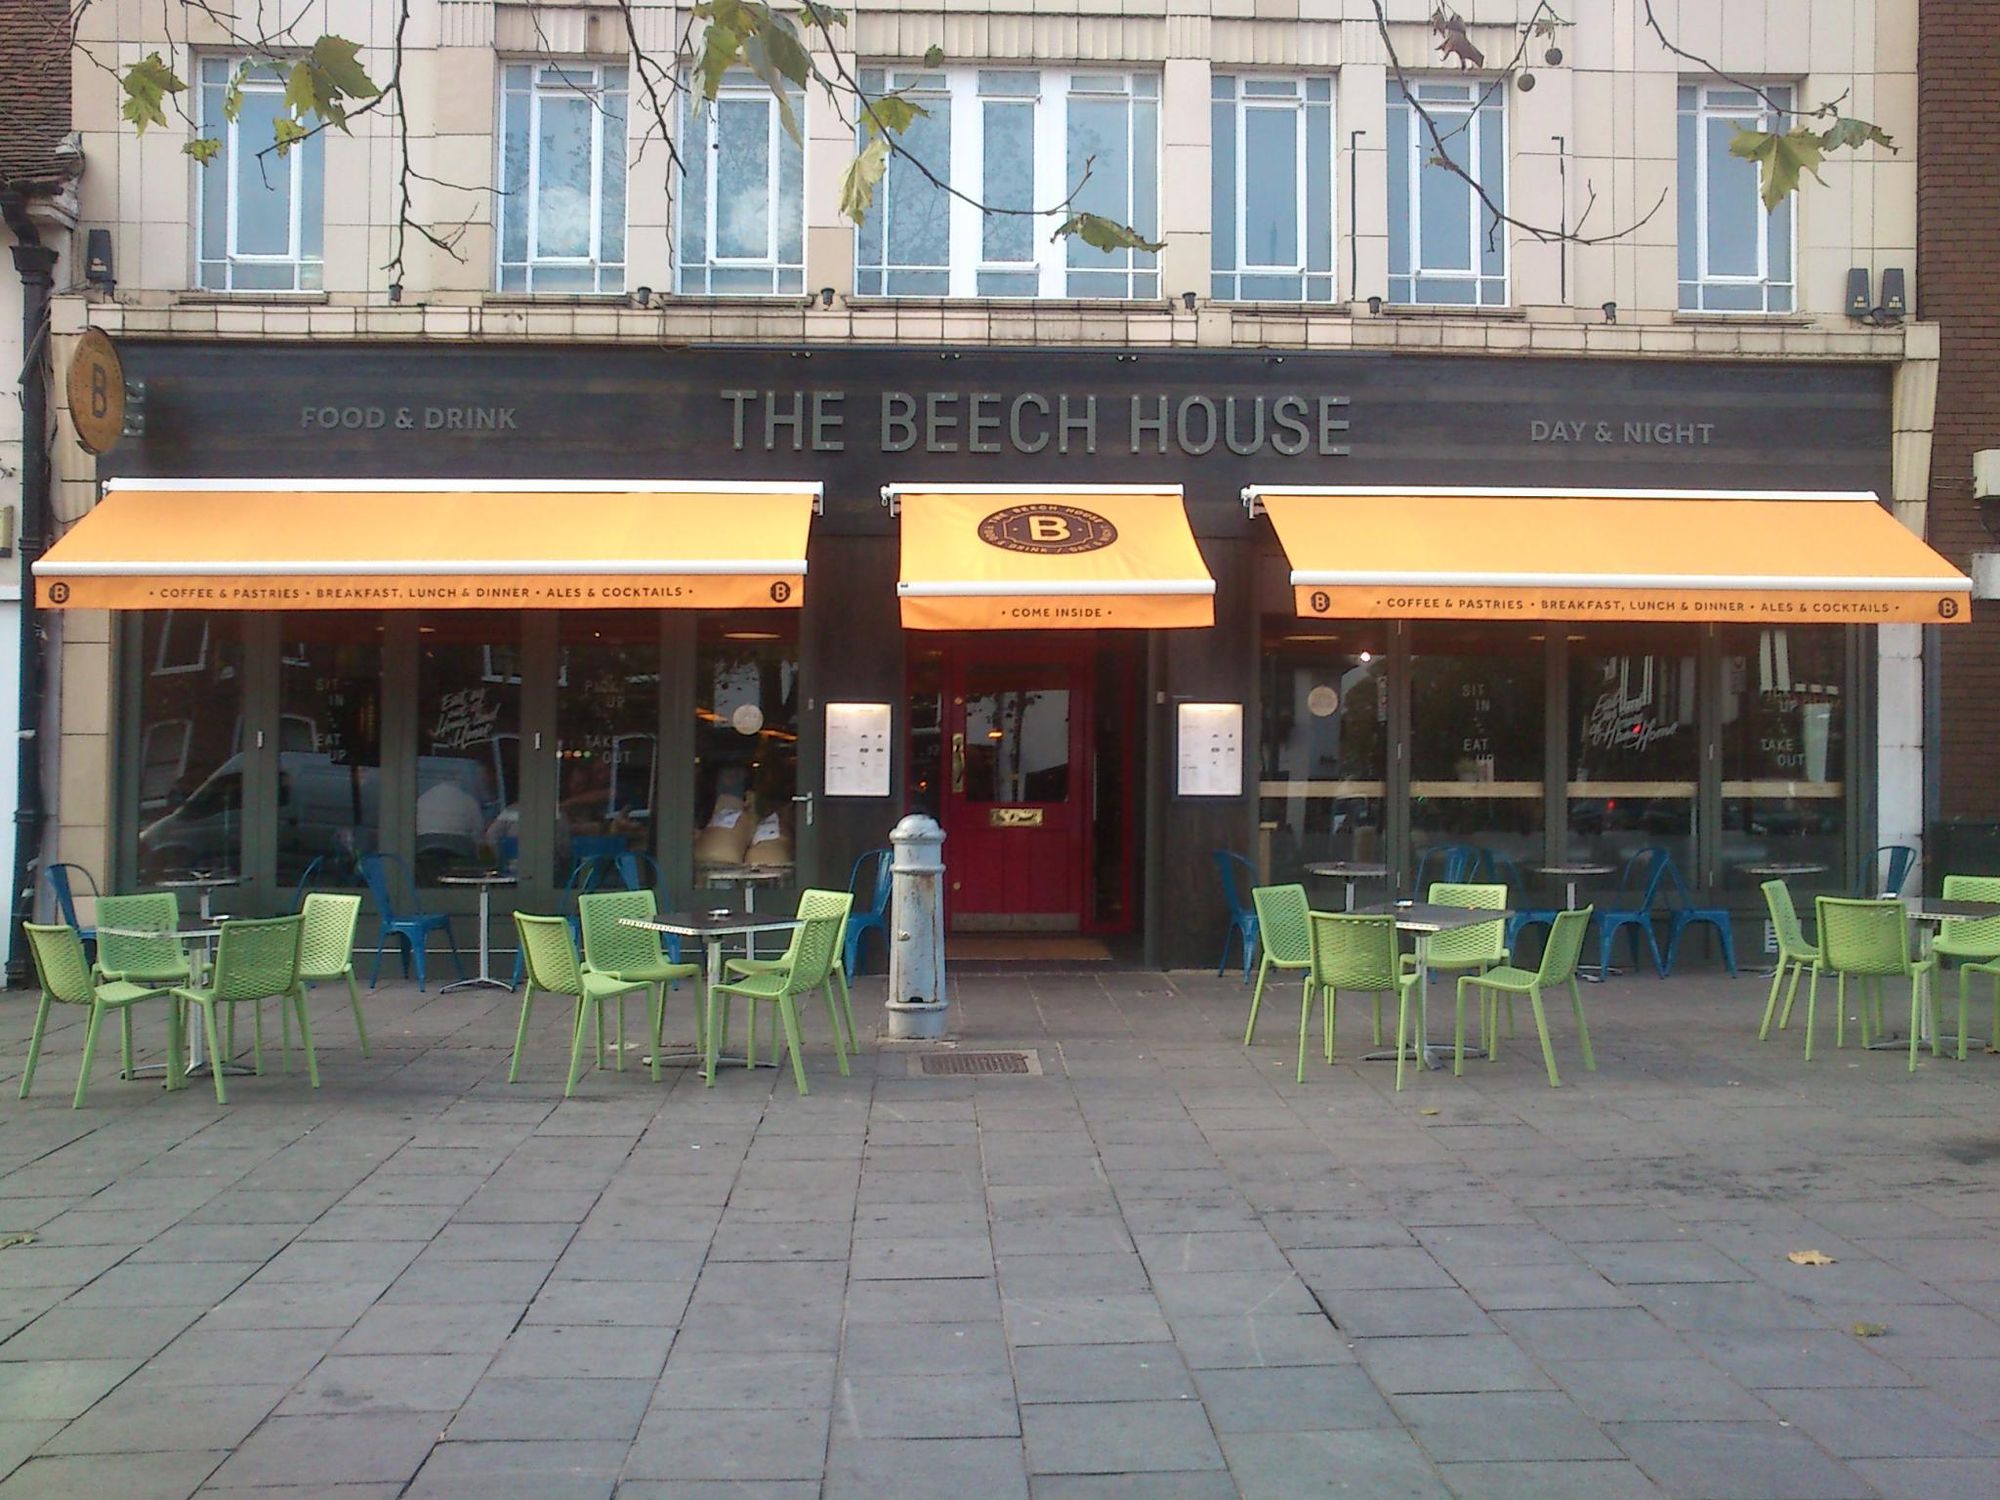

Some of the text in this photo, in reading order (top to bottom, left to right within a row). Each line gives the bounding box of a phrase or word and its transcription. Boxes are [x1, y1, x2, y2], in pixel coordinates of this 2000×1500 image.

[301, 406, 518, 431] FOOD & DRINK
[720, 389, 1351, 456] THE BEECH HOUSE
[1529, 420, 1716, 444] DAY & NIGHT
[1028, 514, 1072, 542] B
[159, 588, 213, 599] COFFEE
[219, 588, 227, 599] &
[233, 588, 300, 599] PASTRIES
[408, 587, 457, 598] LUNCH
[461, 587, 469, 598] &
[476, 587, 529, 598] DINNER
[546, 587, 582, 598] ALES
[587, 587, 596, 598] &
[601, 587, 683, 598] COCKTAILS
[1387, 597, 1890, 613] COFFEE & PASTRIES BREAKFAST, LUNCH & DINNER ALES & COCKTAILS
[1011, 608, 1102, 618] COME INSIDE
[1462, 683, 1485, 697] SIT
[1475, 699, 1491, 712] IN
[1463, 738, 1489, 752] EAT
[1760, 738, 1794, 752] TAKE
[1777, 753, 1807, 767] OUT
